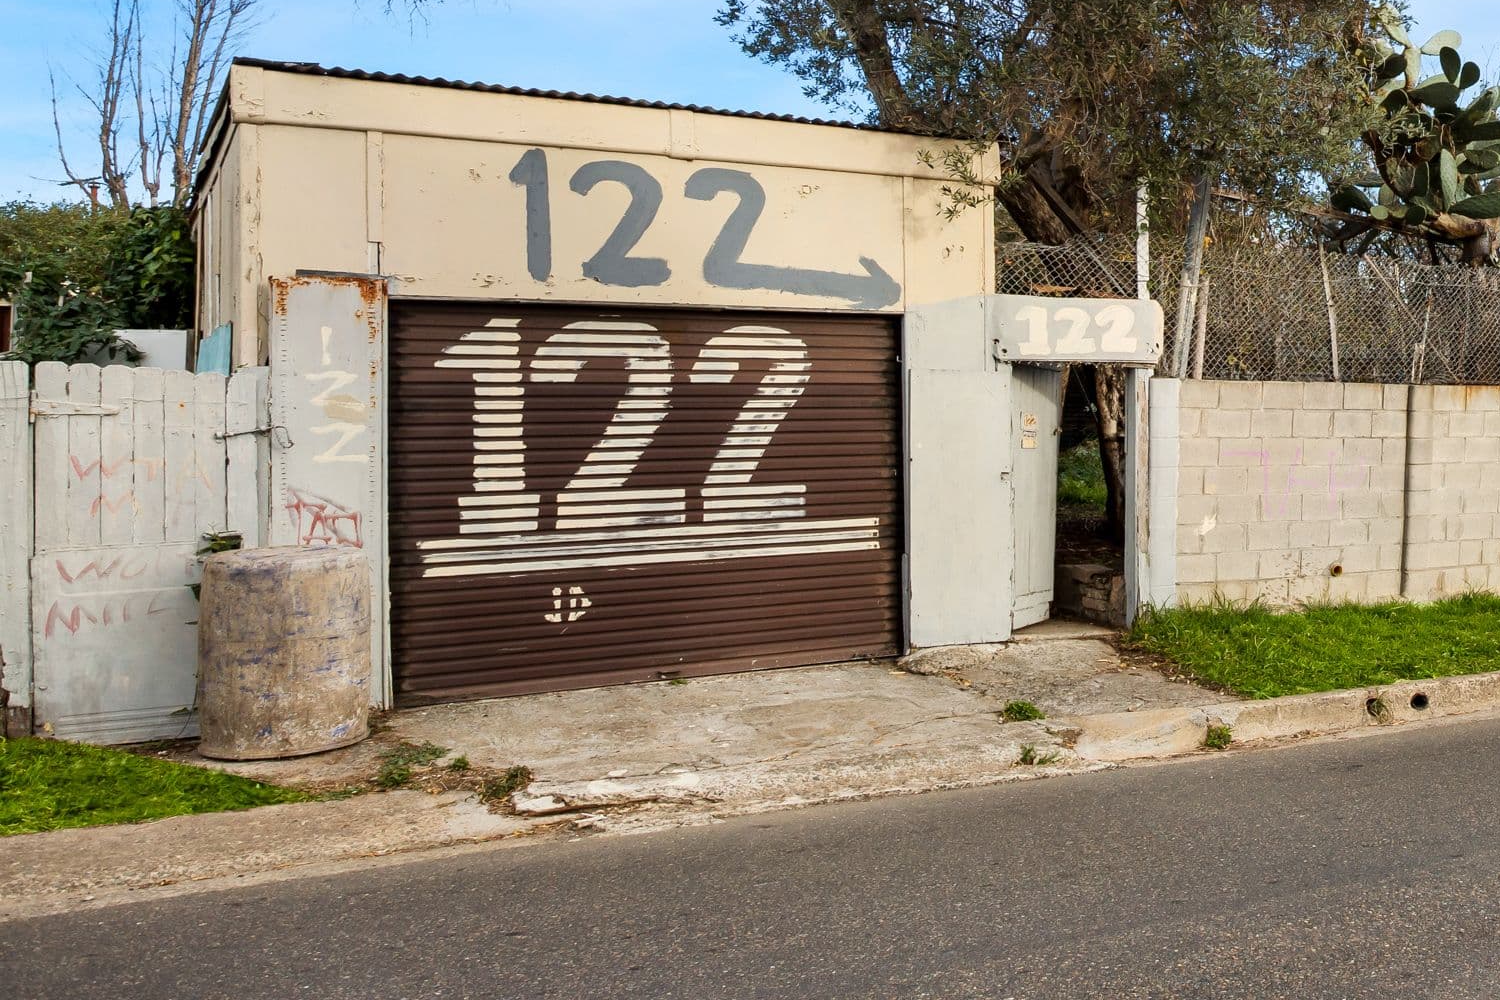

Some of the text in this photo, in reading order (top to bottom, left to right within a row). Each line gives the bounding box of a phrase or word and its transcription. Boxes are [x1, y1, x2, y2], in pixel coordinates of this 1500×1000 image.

[509, 148, 775, 292] 122
[1015, 304, 1138, 356] 122
[433, 318, 813, 534] 122
